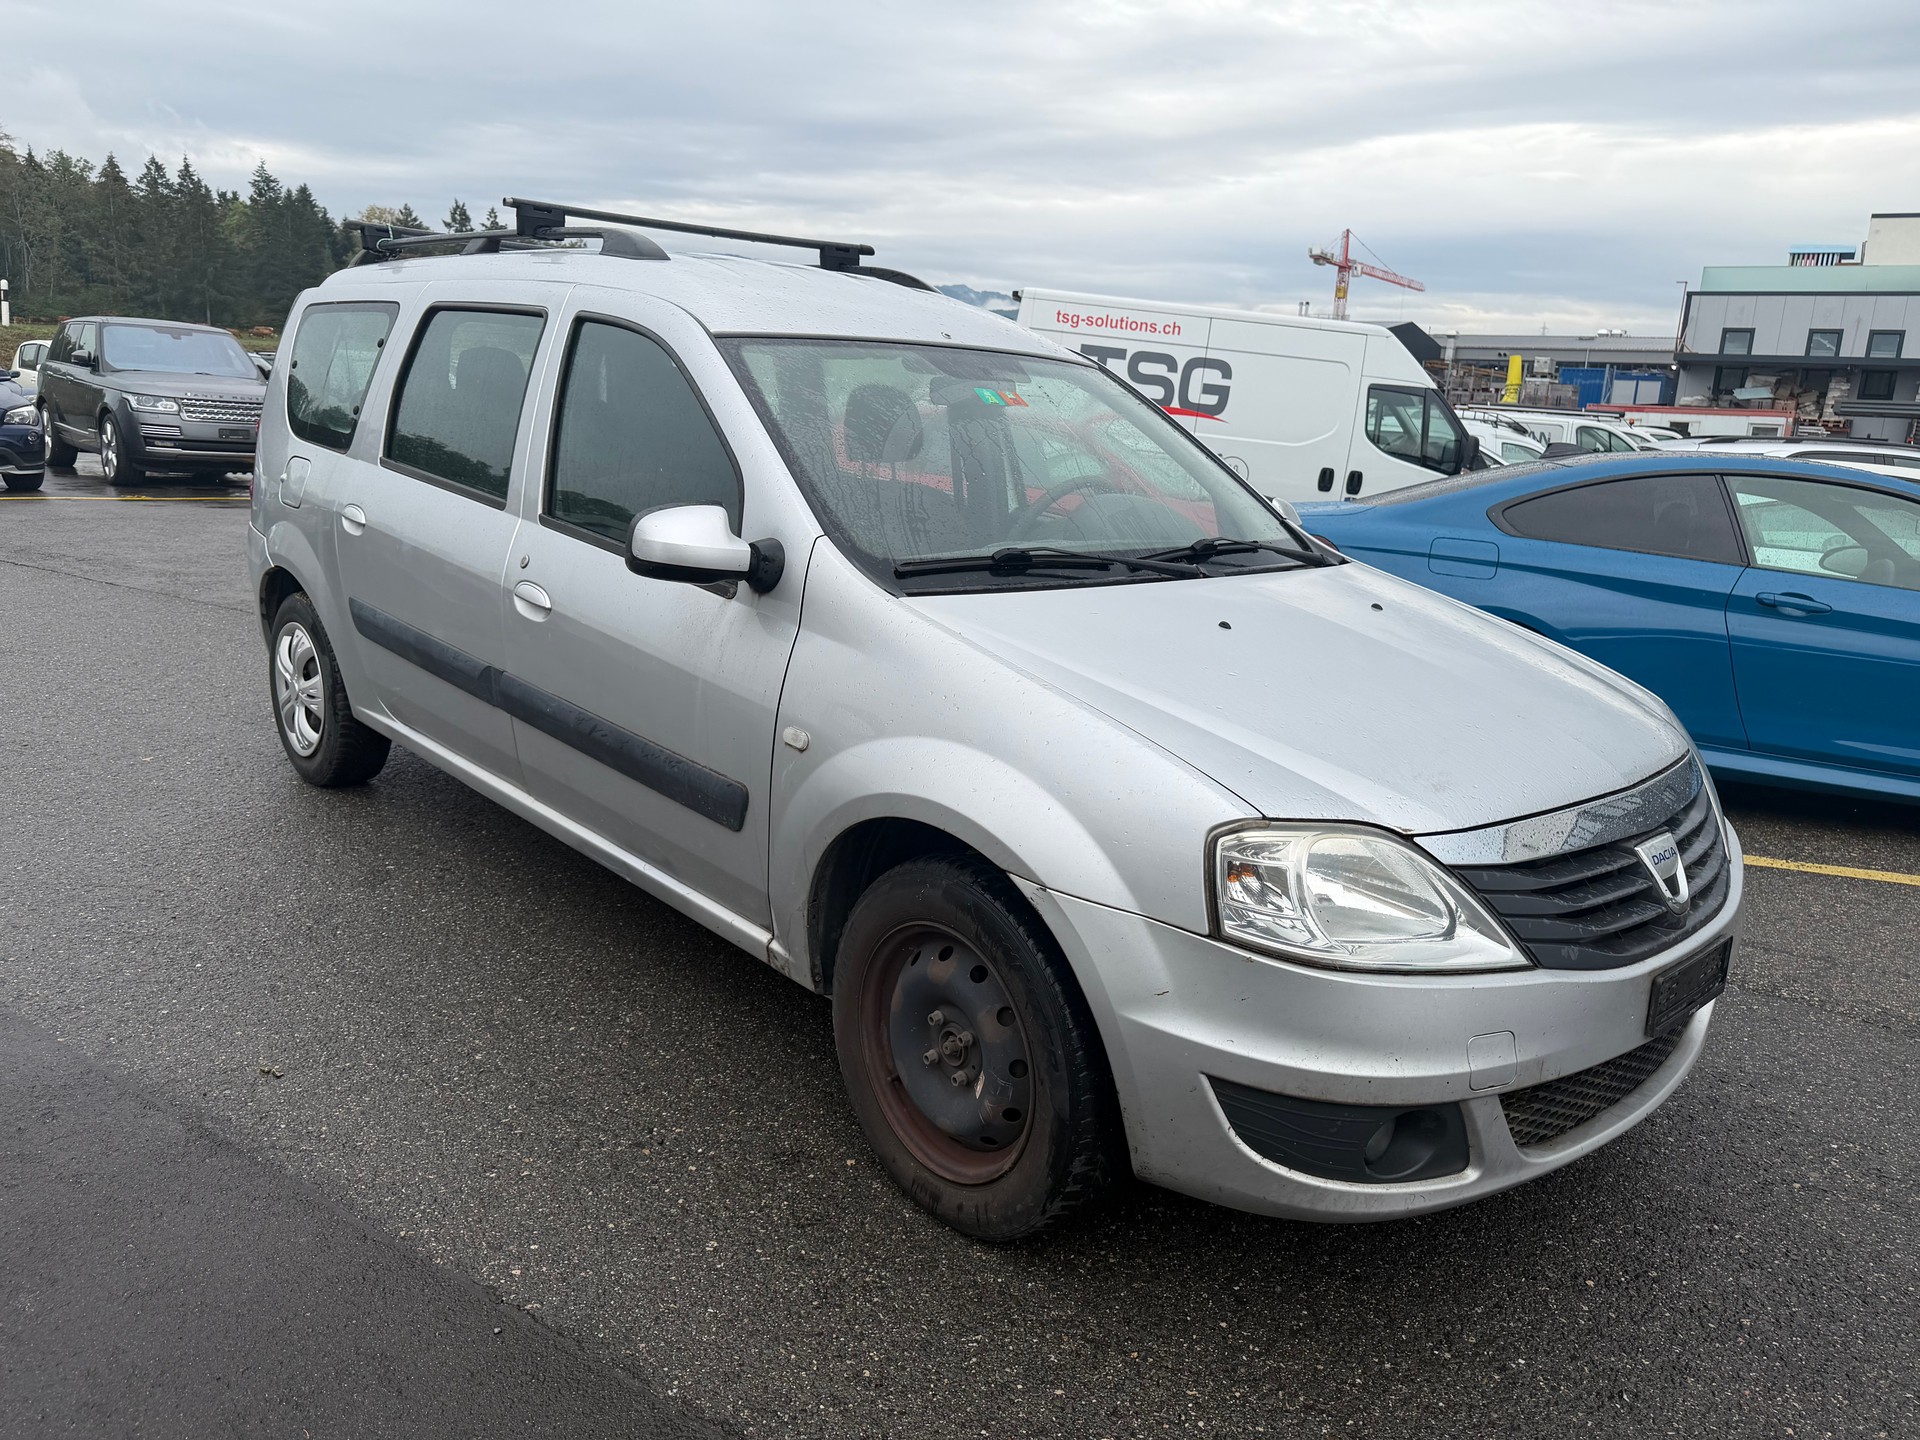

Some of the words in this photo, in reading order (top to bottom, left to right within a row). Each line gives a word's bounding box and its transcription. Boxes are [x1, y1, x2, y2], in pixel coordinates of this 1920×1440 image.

[1055, 309, 1182, 336] tsg-solutions.ch
[1080, 343, 1233, 417] TSG
[1651, 846, 1677, 866] DACIA
